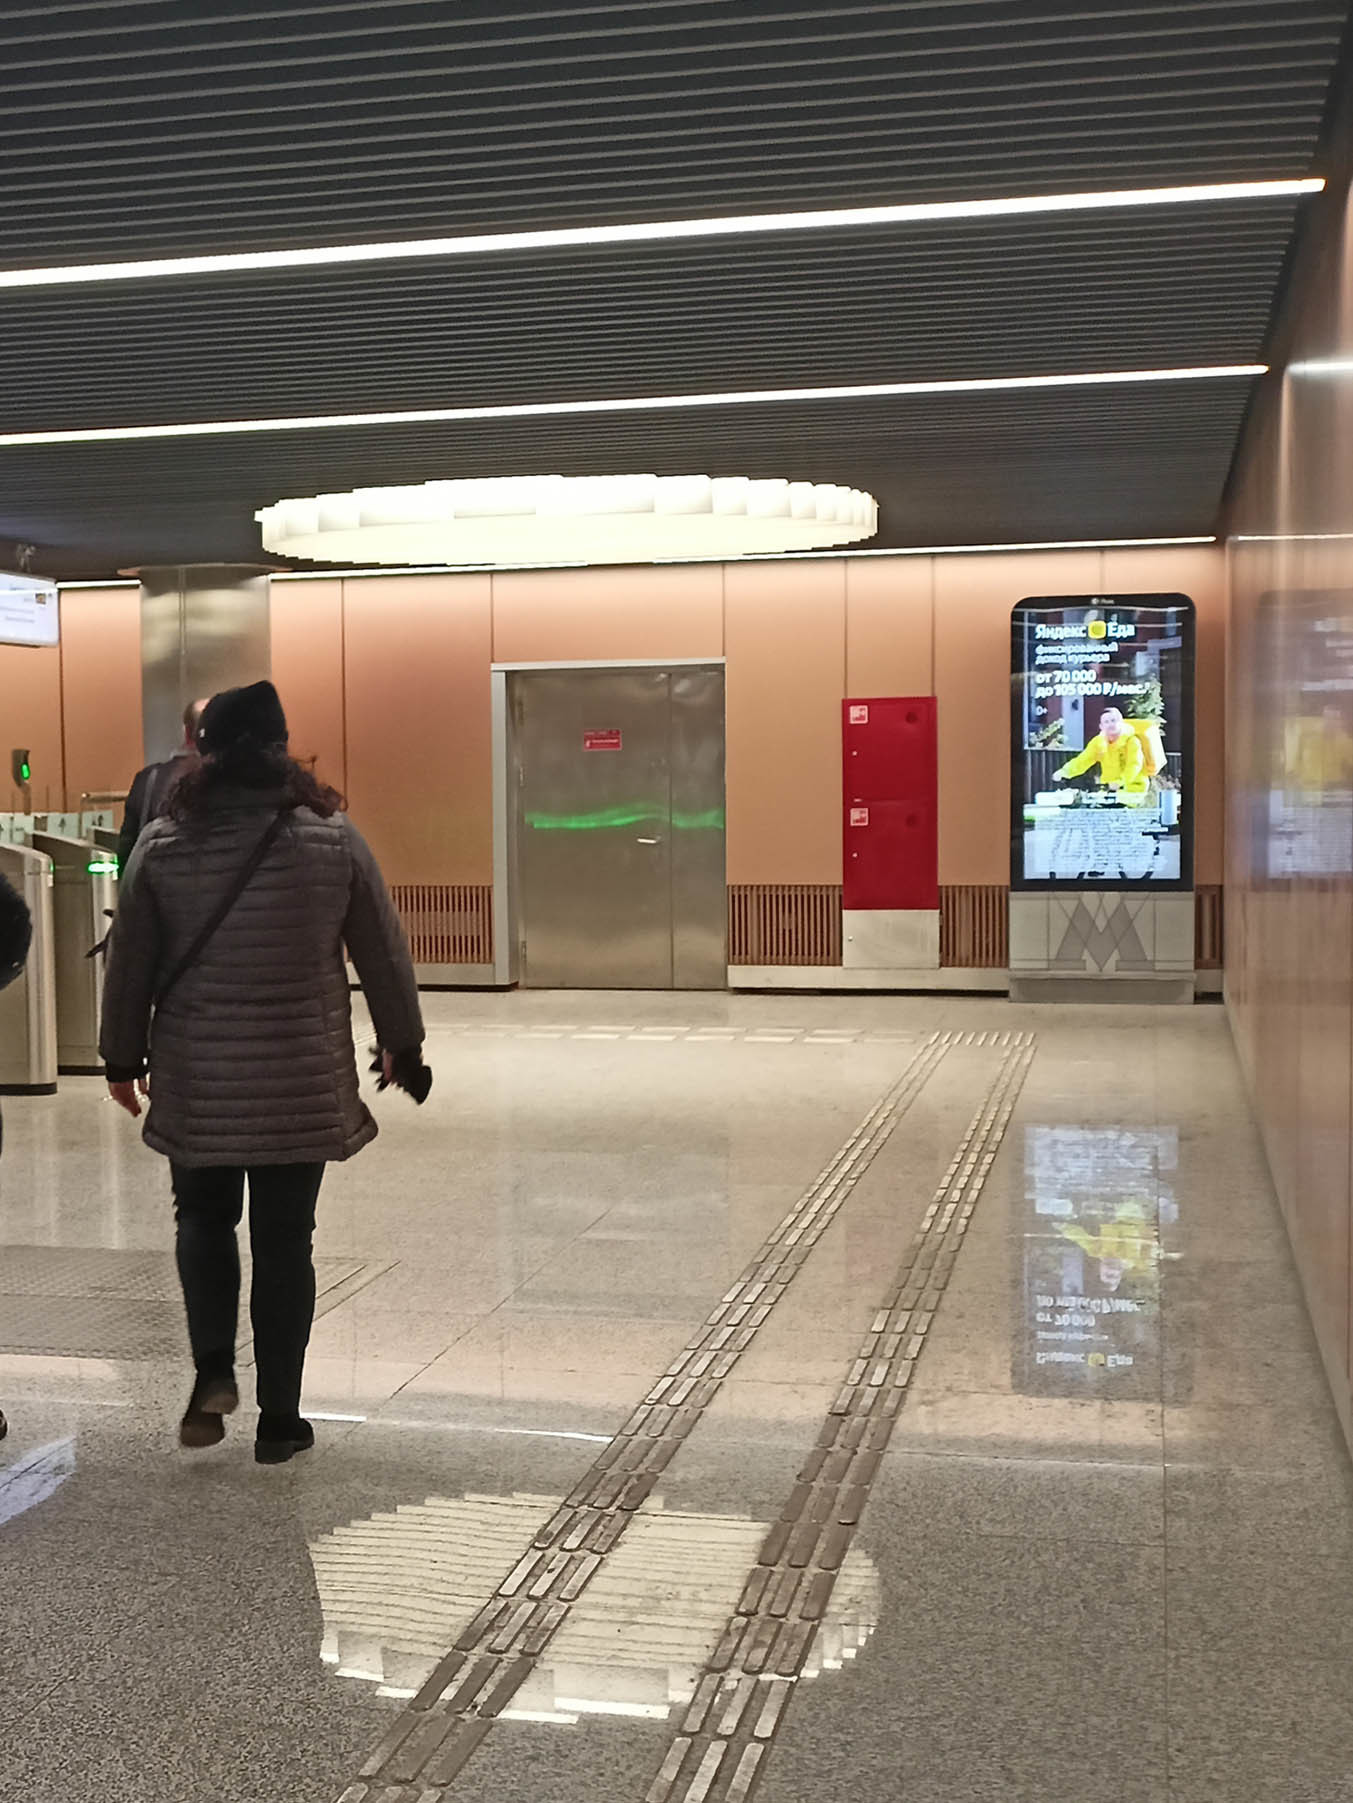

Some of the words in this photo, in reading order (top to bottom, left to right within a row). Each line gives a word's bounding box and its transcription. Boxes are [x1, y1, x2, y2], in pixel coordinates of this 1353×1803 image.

[1035, 624, 1087, 640] Яндекс
[1107, 622, 1135, 639] Еда
[1035, 673, 1052, 683] от
[1053, 670, 1070, 683] 70
[1071, 669, 1097, 683] 000
[1035, 687, 1054, 699] до
[1054, 684, 1076, 697] 105
[1077, 683, 1103, 696] 000
